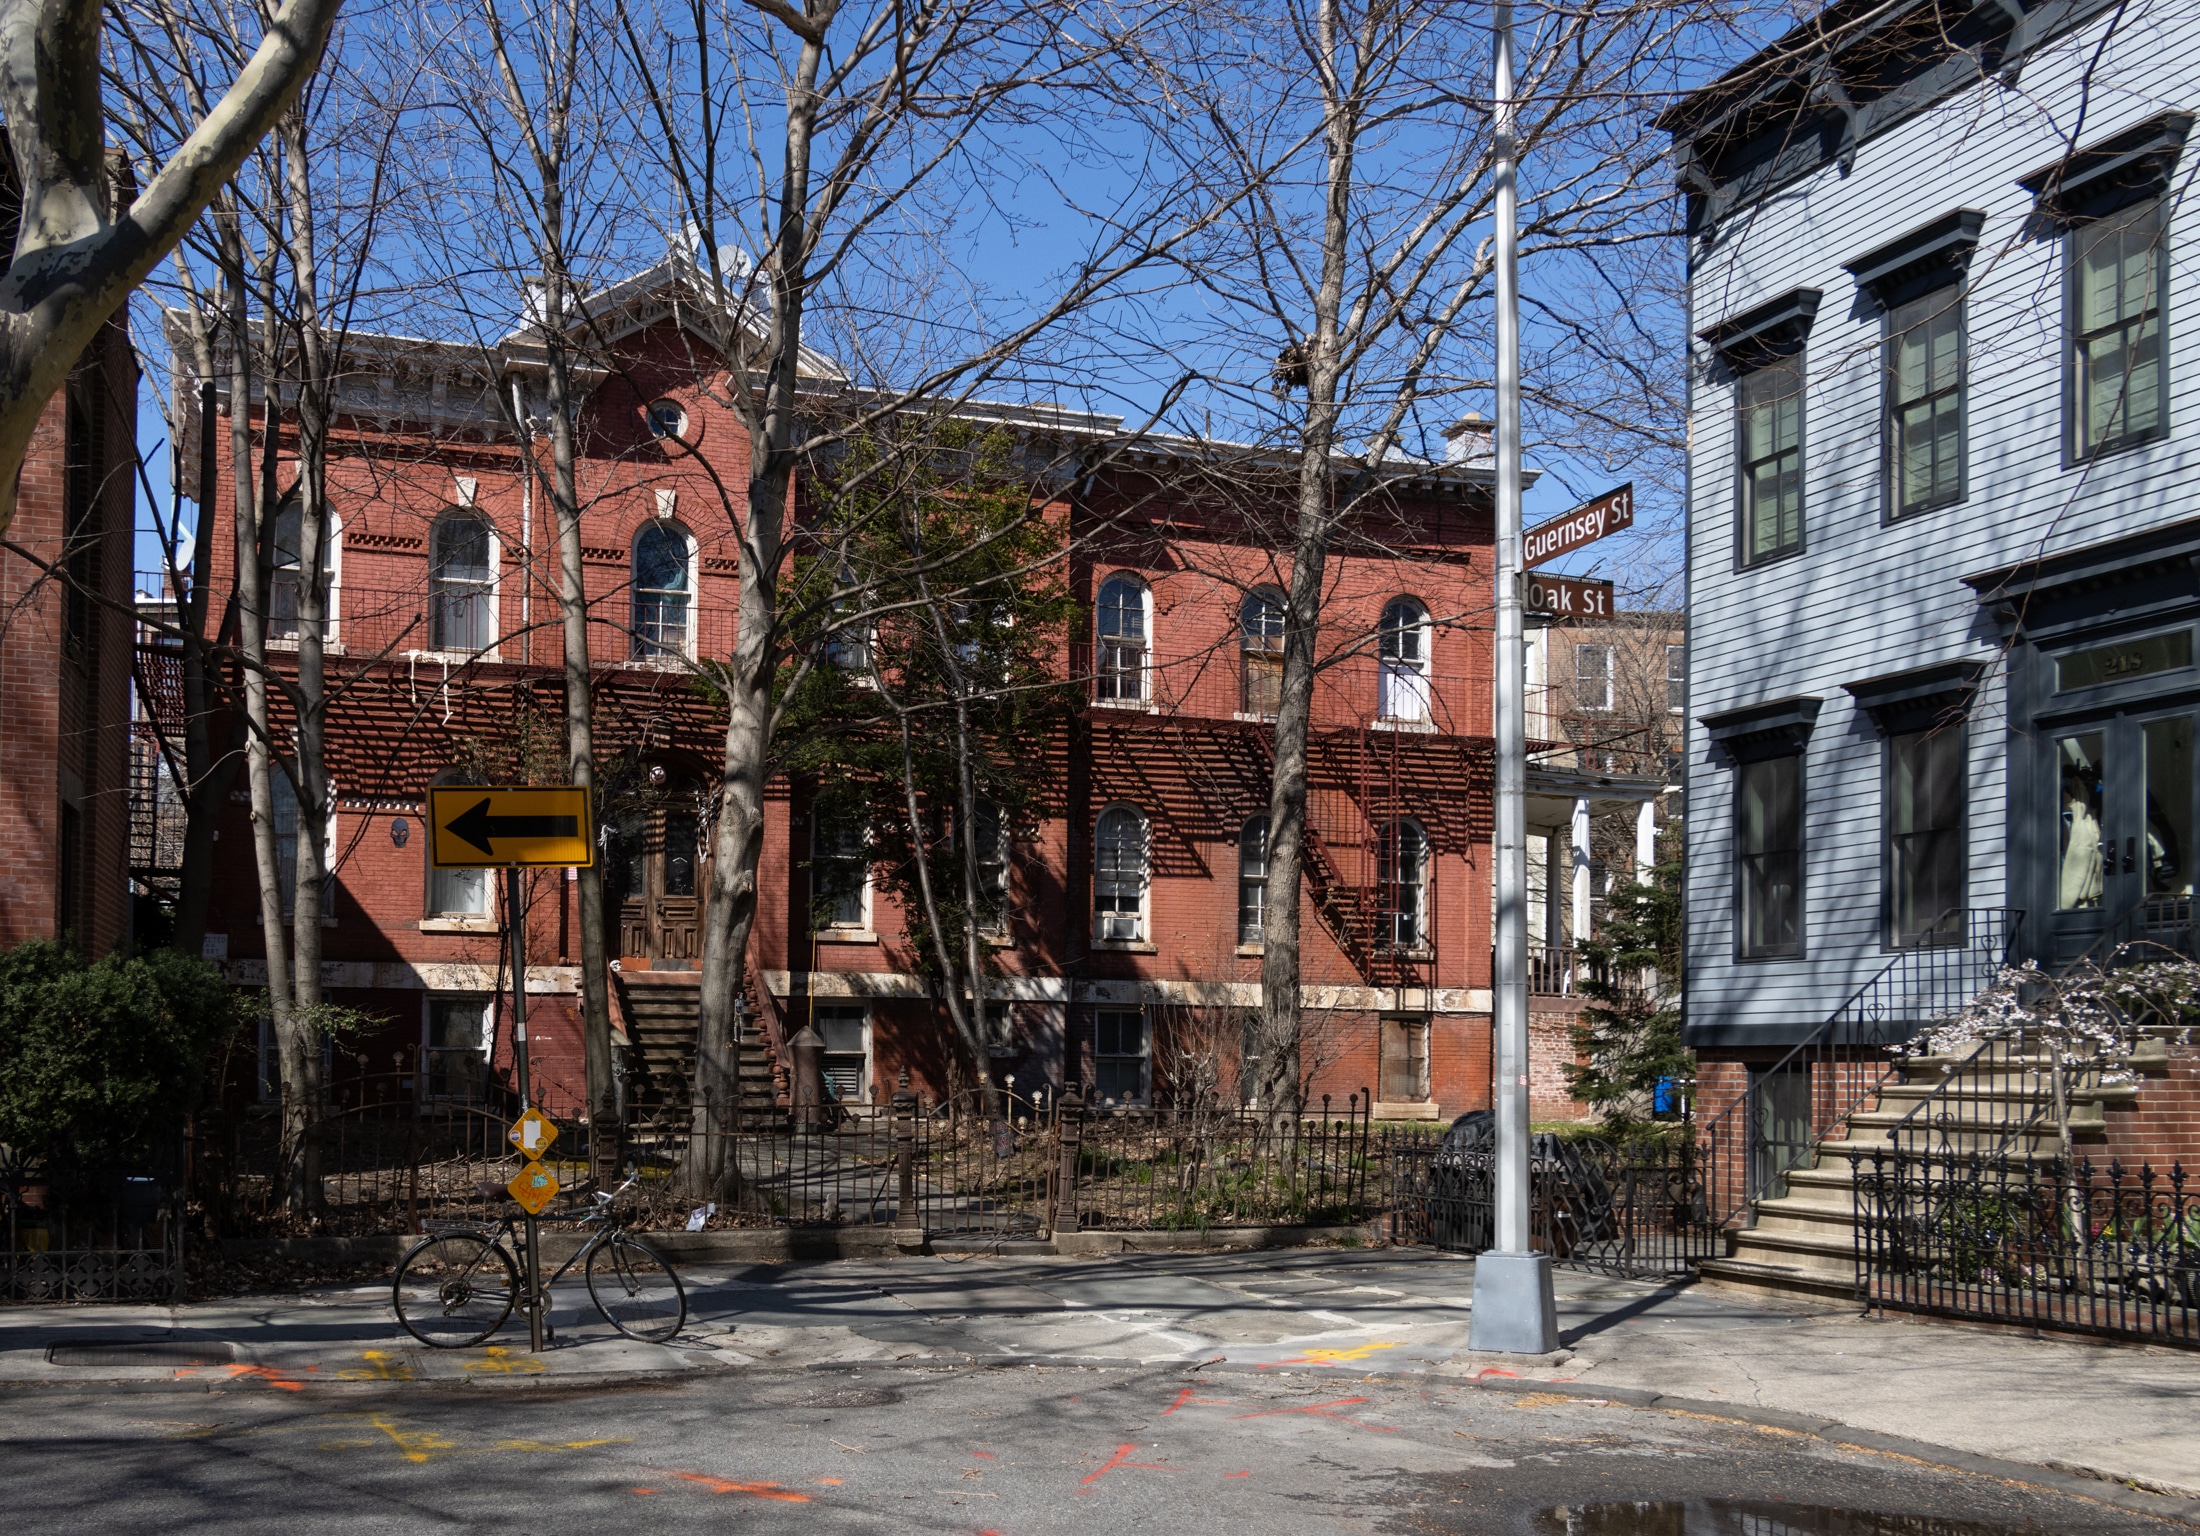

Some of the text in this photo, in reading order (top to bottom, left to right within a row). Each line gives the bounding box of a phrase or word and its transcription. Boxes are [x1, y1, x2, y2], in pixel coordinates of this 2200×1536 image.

[1524, 502, 1590, 535] GREENPOINT HISTORIC DISTRICT
[1524, 492, 1630, 560] Guernsey St
[1559, 575, 1581, 583] HISTORIC
[1582, 578, 1603, 586] DISTRICT
[1530, 583, 1605, 615] Oak St
